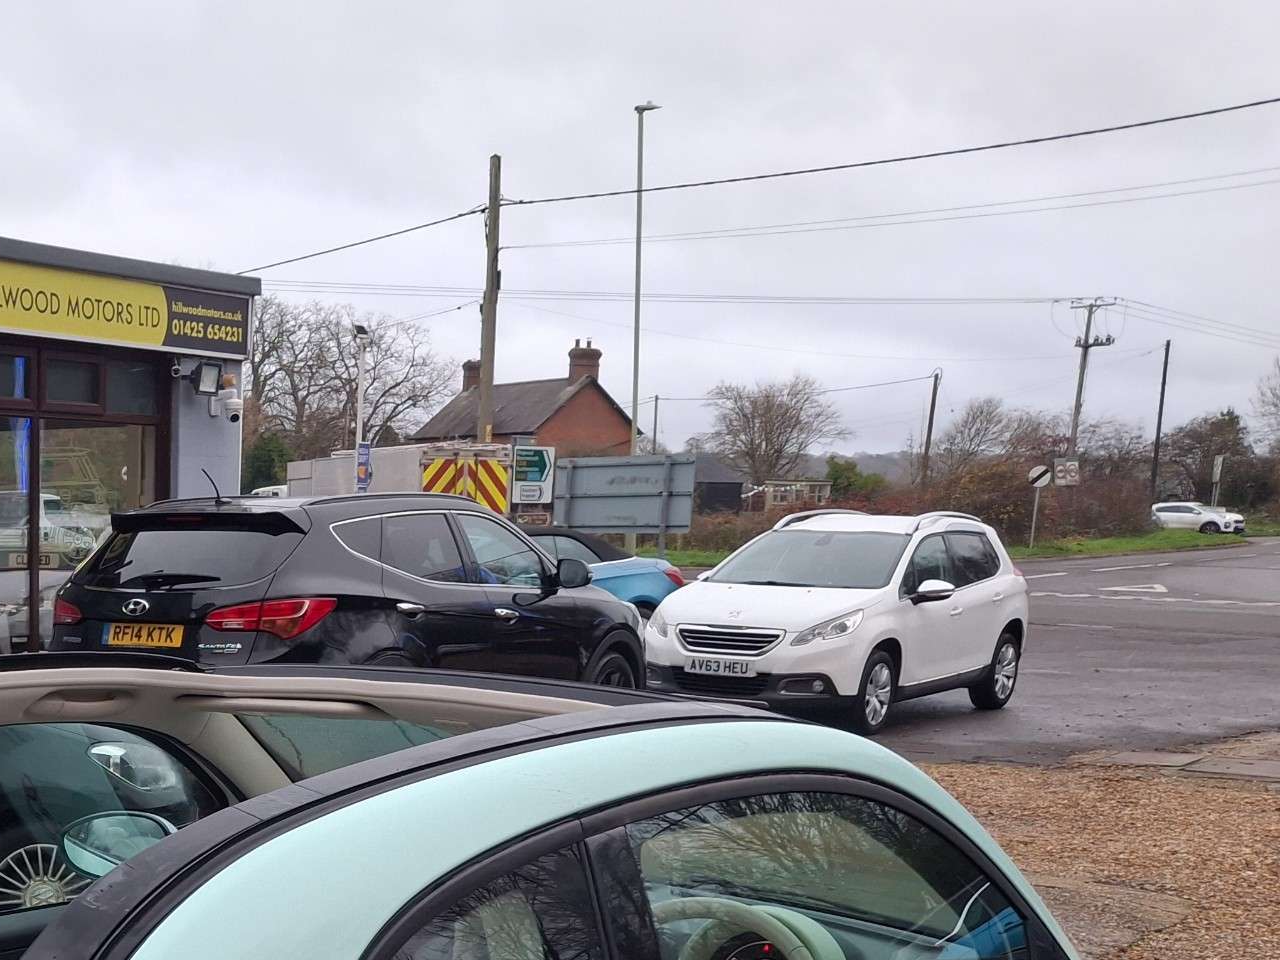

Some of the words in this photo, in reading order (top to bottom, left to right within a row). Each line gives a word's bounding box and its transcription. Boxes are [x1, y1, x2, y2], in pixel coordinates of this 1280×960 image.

[67, 295, 133, 325] MOTORS
[138, 305, 160, 328] LTD
[172, 301, 242, 320] hillwoodmotors.co.uk
[172, 319, 203, 338] 01425
[207, 324, 242, 342] 654231
[16, 554, 51, 566] CLED
[112, 625, 143, 642] RF14
[146, 626, 176, 643] KTK
[689, 659, 720, 672] AV63
[723, 661, 749, 674] HEU
